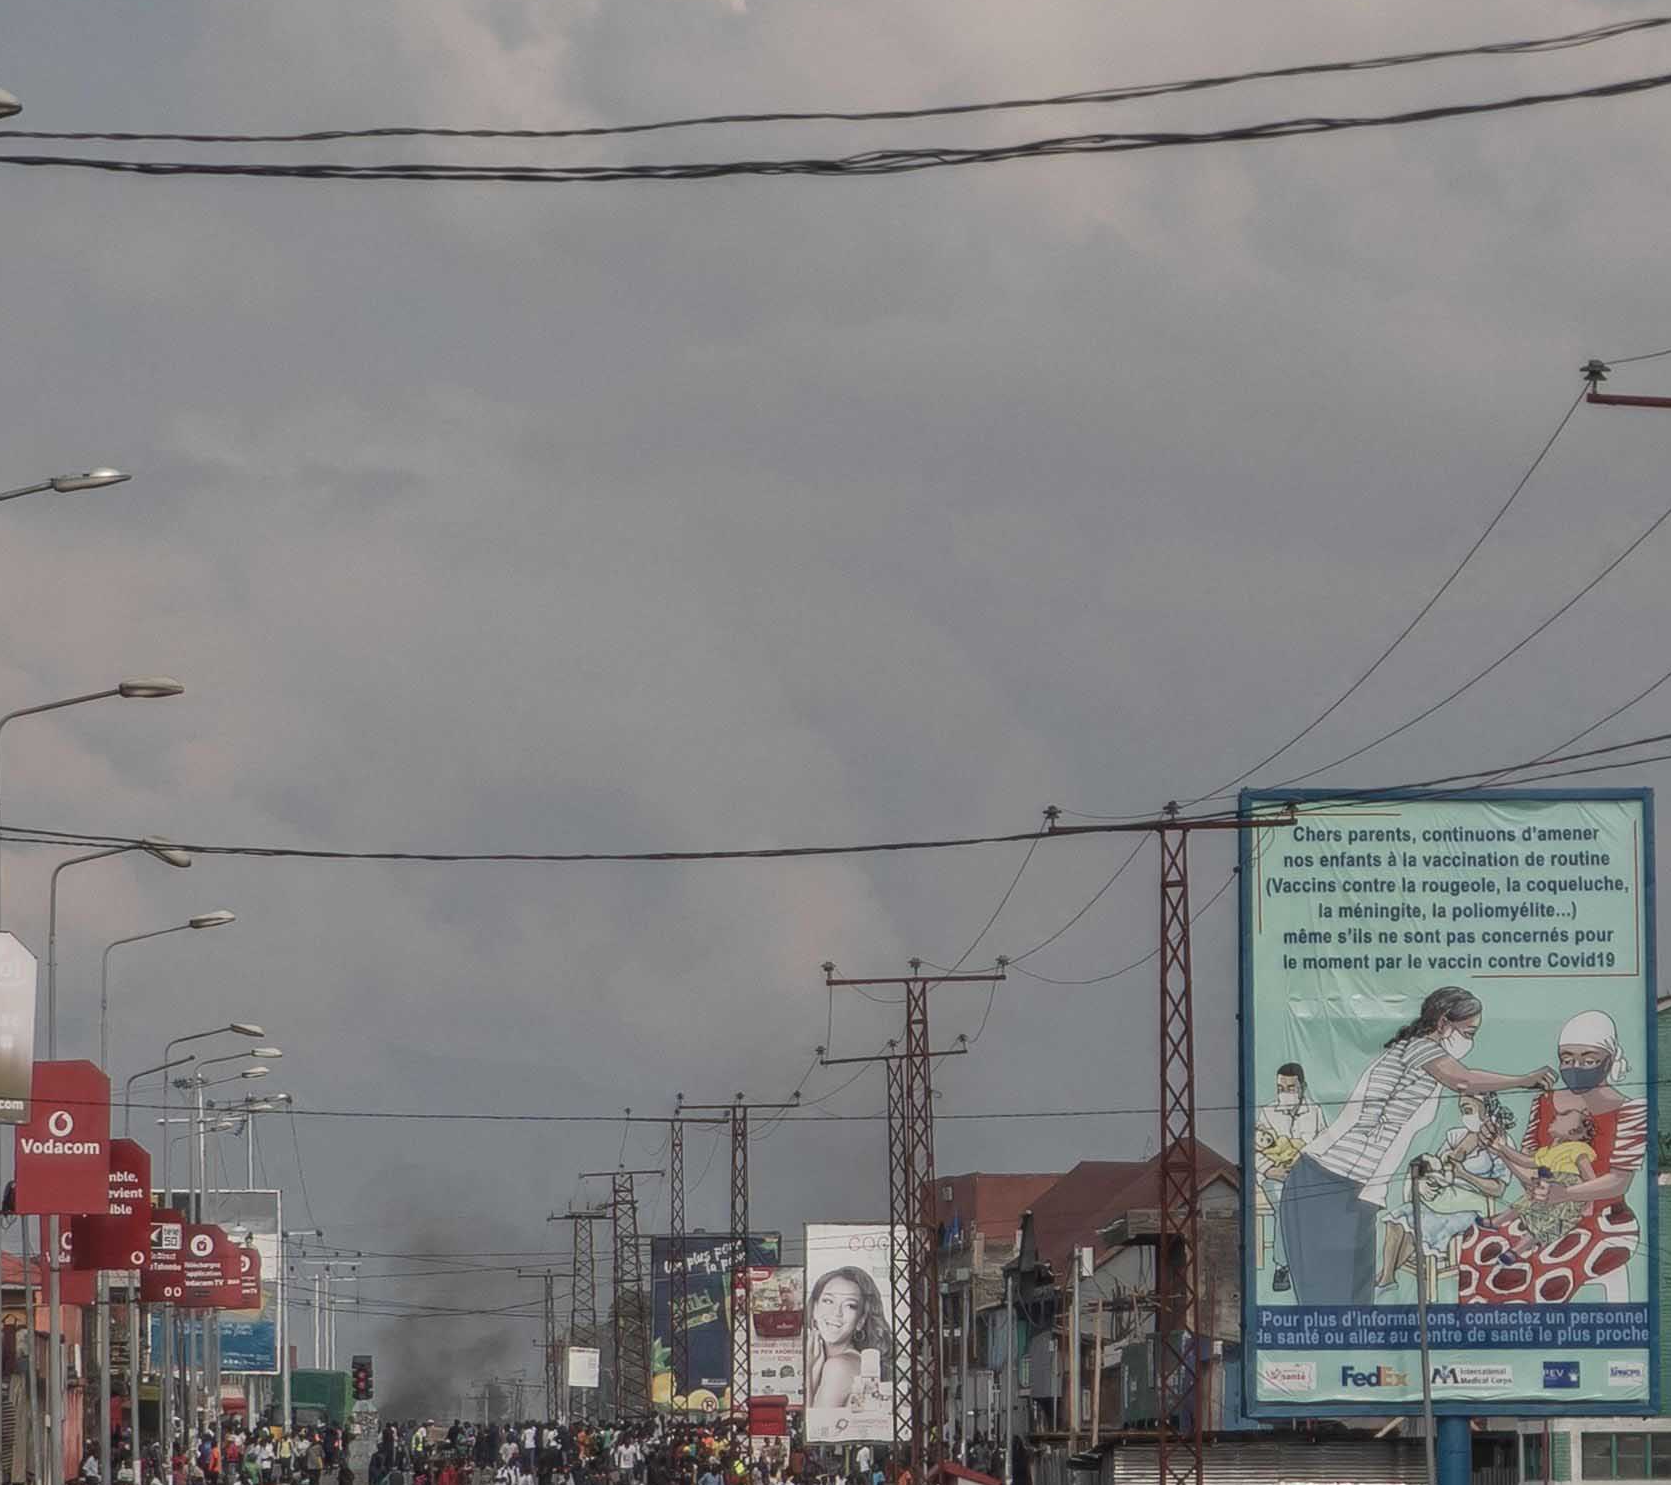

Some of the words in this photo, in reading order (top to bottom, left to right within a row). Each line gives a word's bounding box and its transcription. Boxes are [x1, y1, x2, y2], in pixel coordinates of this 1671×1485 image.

[1293, 826, 1342, 842] Chers
[1348, 827, 1416, 846] parents,
[1422, 826, 1516, 843] continuons
[1521, 826, 1599, 842] d'amener
[1283, 855, 1314, 868] nos
[1319, 851, 1382, 867] enfants
[1387, 851, 1397, 867] à
[1402, 851, 1417, 868] la
[1422, 851, 1519, 868] vaccination
[1524, 851, 1545, 867] de
[1550, 850, 1611, 867] routine
[1266, 877, 1337, 897] (Vaccins
[1342, 878, 1396, 893] contre
[1401, 877, 1416, 893] la
[1422, 877, 1500, 897] rougeole,
[1506, 876, 1521, 892] la
[1526, 875, 1629, 895] coqueluche,
[1318, 903, 1333, 919] la
[1338, 902, 1426, 922] méningite,
[1432, 902, 1447, 918] la
[1452, 901, 1577, 922] poliomyélite...)
[1283, 928, 1332, 944] même
[1337, 928, 1373, 944] s'ils
[1378, 931, 1398, 944] ne
[1403, 929, 1441, 944] sont
[1446, 931, 1476, 947] pas
[1481, 926, 1569, 944] concernés
[1575, 929, 1614, 946] pour
[1283, 954, 1297, 970] le
[1302, 955, 1370, 970] moment
[1375, 957, 1402, 973] par
[1408, 953, 1422, 969] le
[1427, 956, 1482, 970] vaccin
[1488, 953, 1542, 969] contre
[1547, 951, 1615, 968] Covid19
[21, 1138, 100, 1155] Vodacom
[1262, 1310, 1300, 1327] Pour
[1304, 1311, 1337, 1332] plus
[1465, 1310, 1541, 1325] contactez
[1545, 1312, 1565, 1324] un
[1570, 1308, 1648, 1328] personnel
[1276, 1328, 1320, 1345] santé
[1324, 1332, 1344, 1345] ou
[1349, 1328, 1385, 1344] allez
[1389, 1331, 1408, 1344] au
[1467, 1326, 1486, 1342] de
[1491, 1325, 1534, 1342] santé
[1538, 1326, 1552, 1342] le
[1557, 1326, 1591, 1345] plus
[1596, 1325, 1649, 1345] proche
[1341, 1365, 1408, 1387] FedEx
